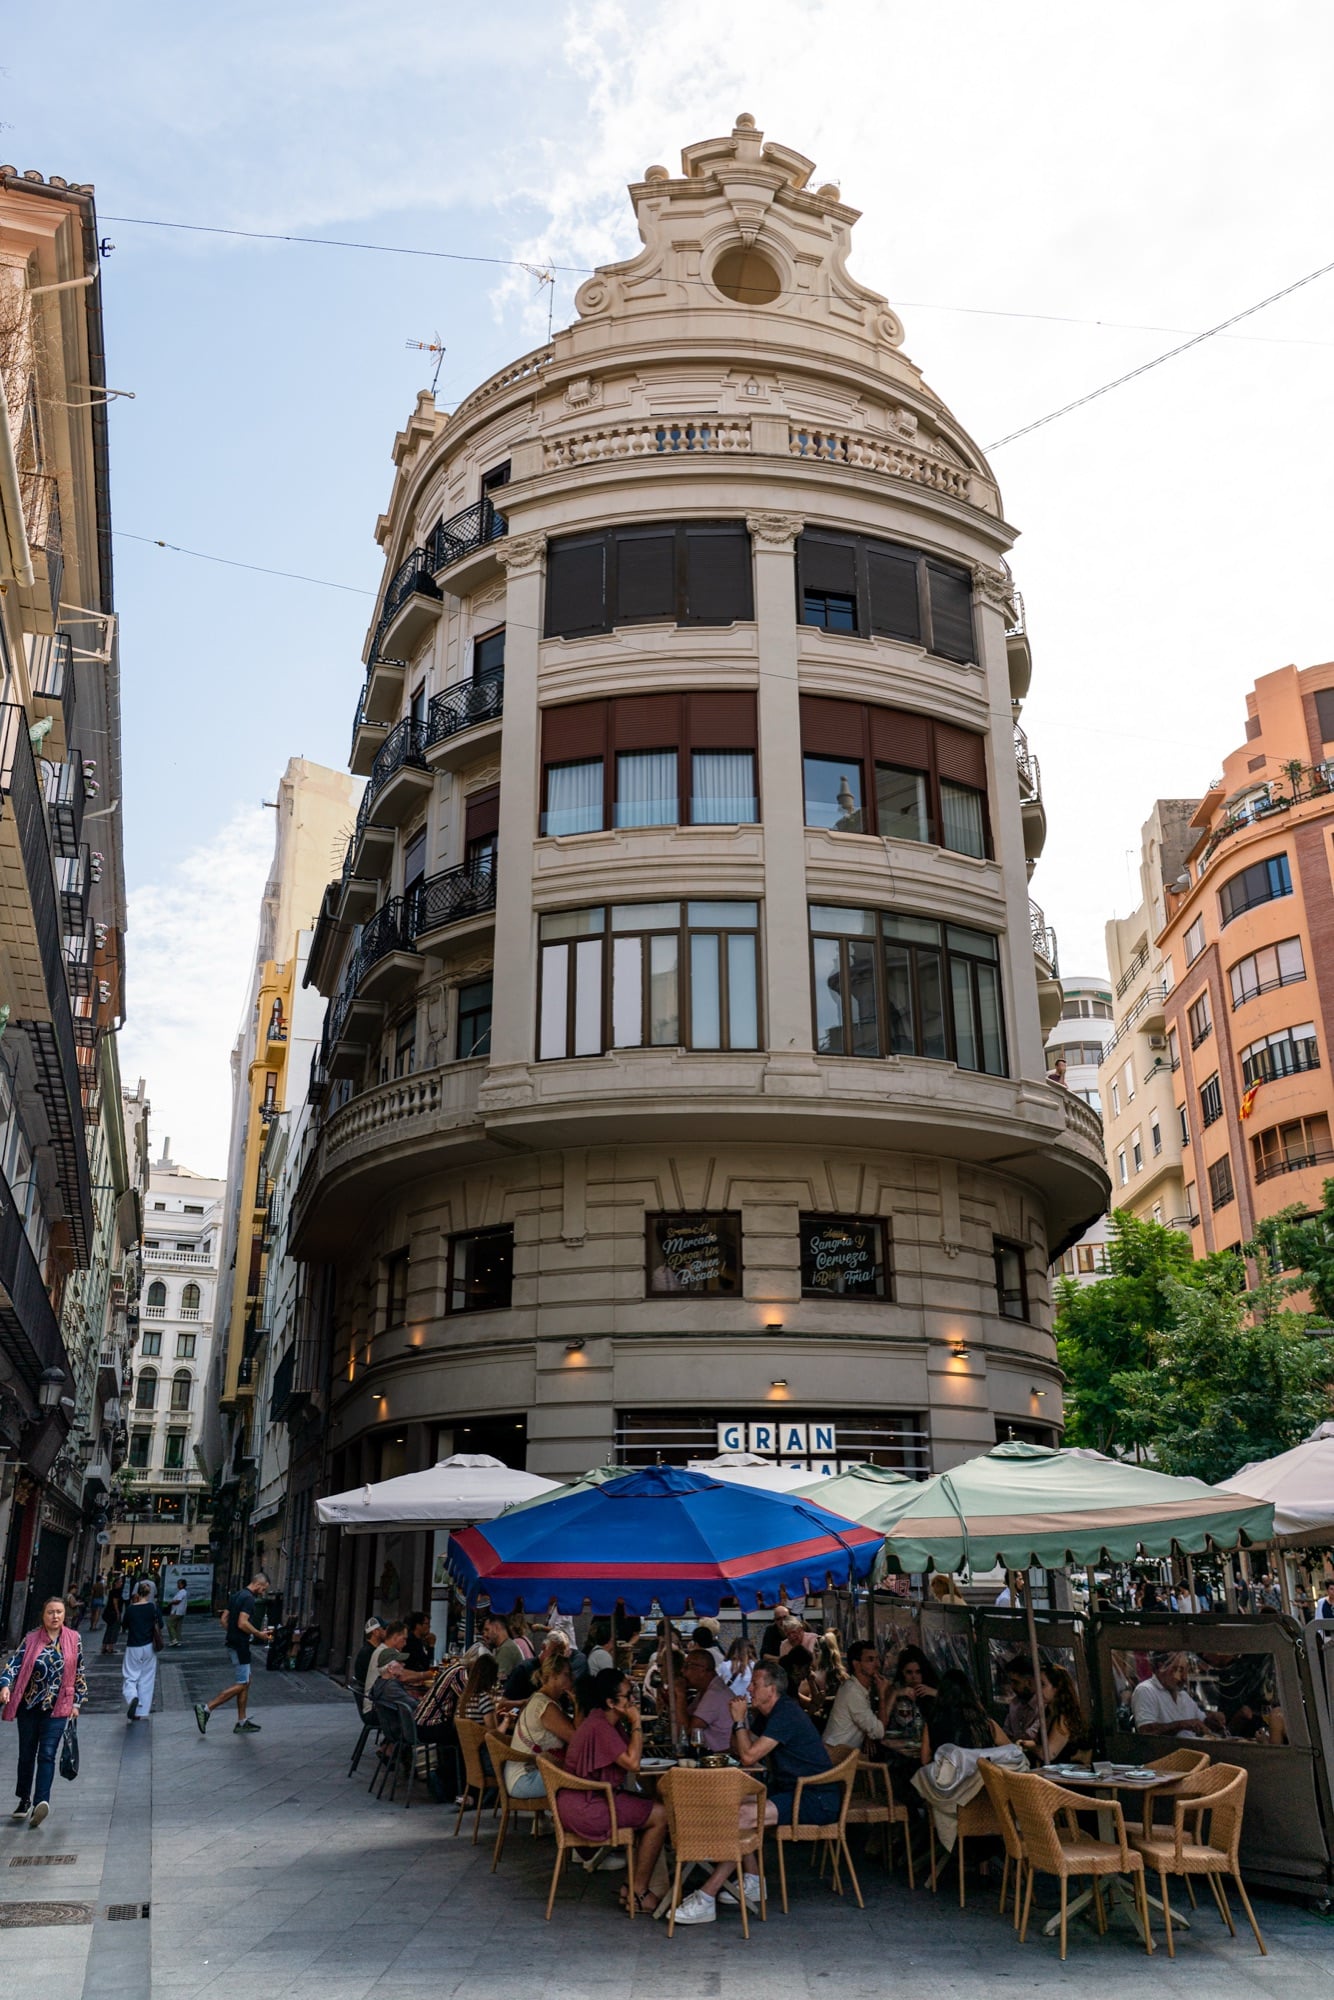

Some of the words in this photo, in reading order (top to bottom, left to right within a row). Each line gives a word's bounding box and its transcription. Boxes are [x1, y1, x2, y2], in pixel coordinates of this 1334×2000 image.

[662, 1232, 718, 1255] Mercado
[690, 1258, 720, 1272] Buen
[816, 1251, 869, 1270] Cerveza
[724, 1427, 832, 1450] GRAN
